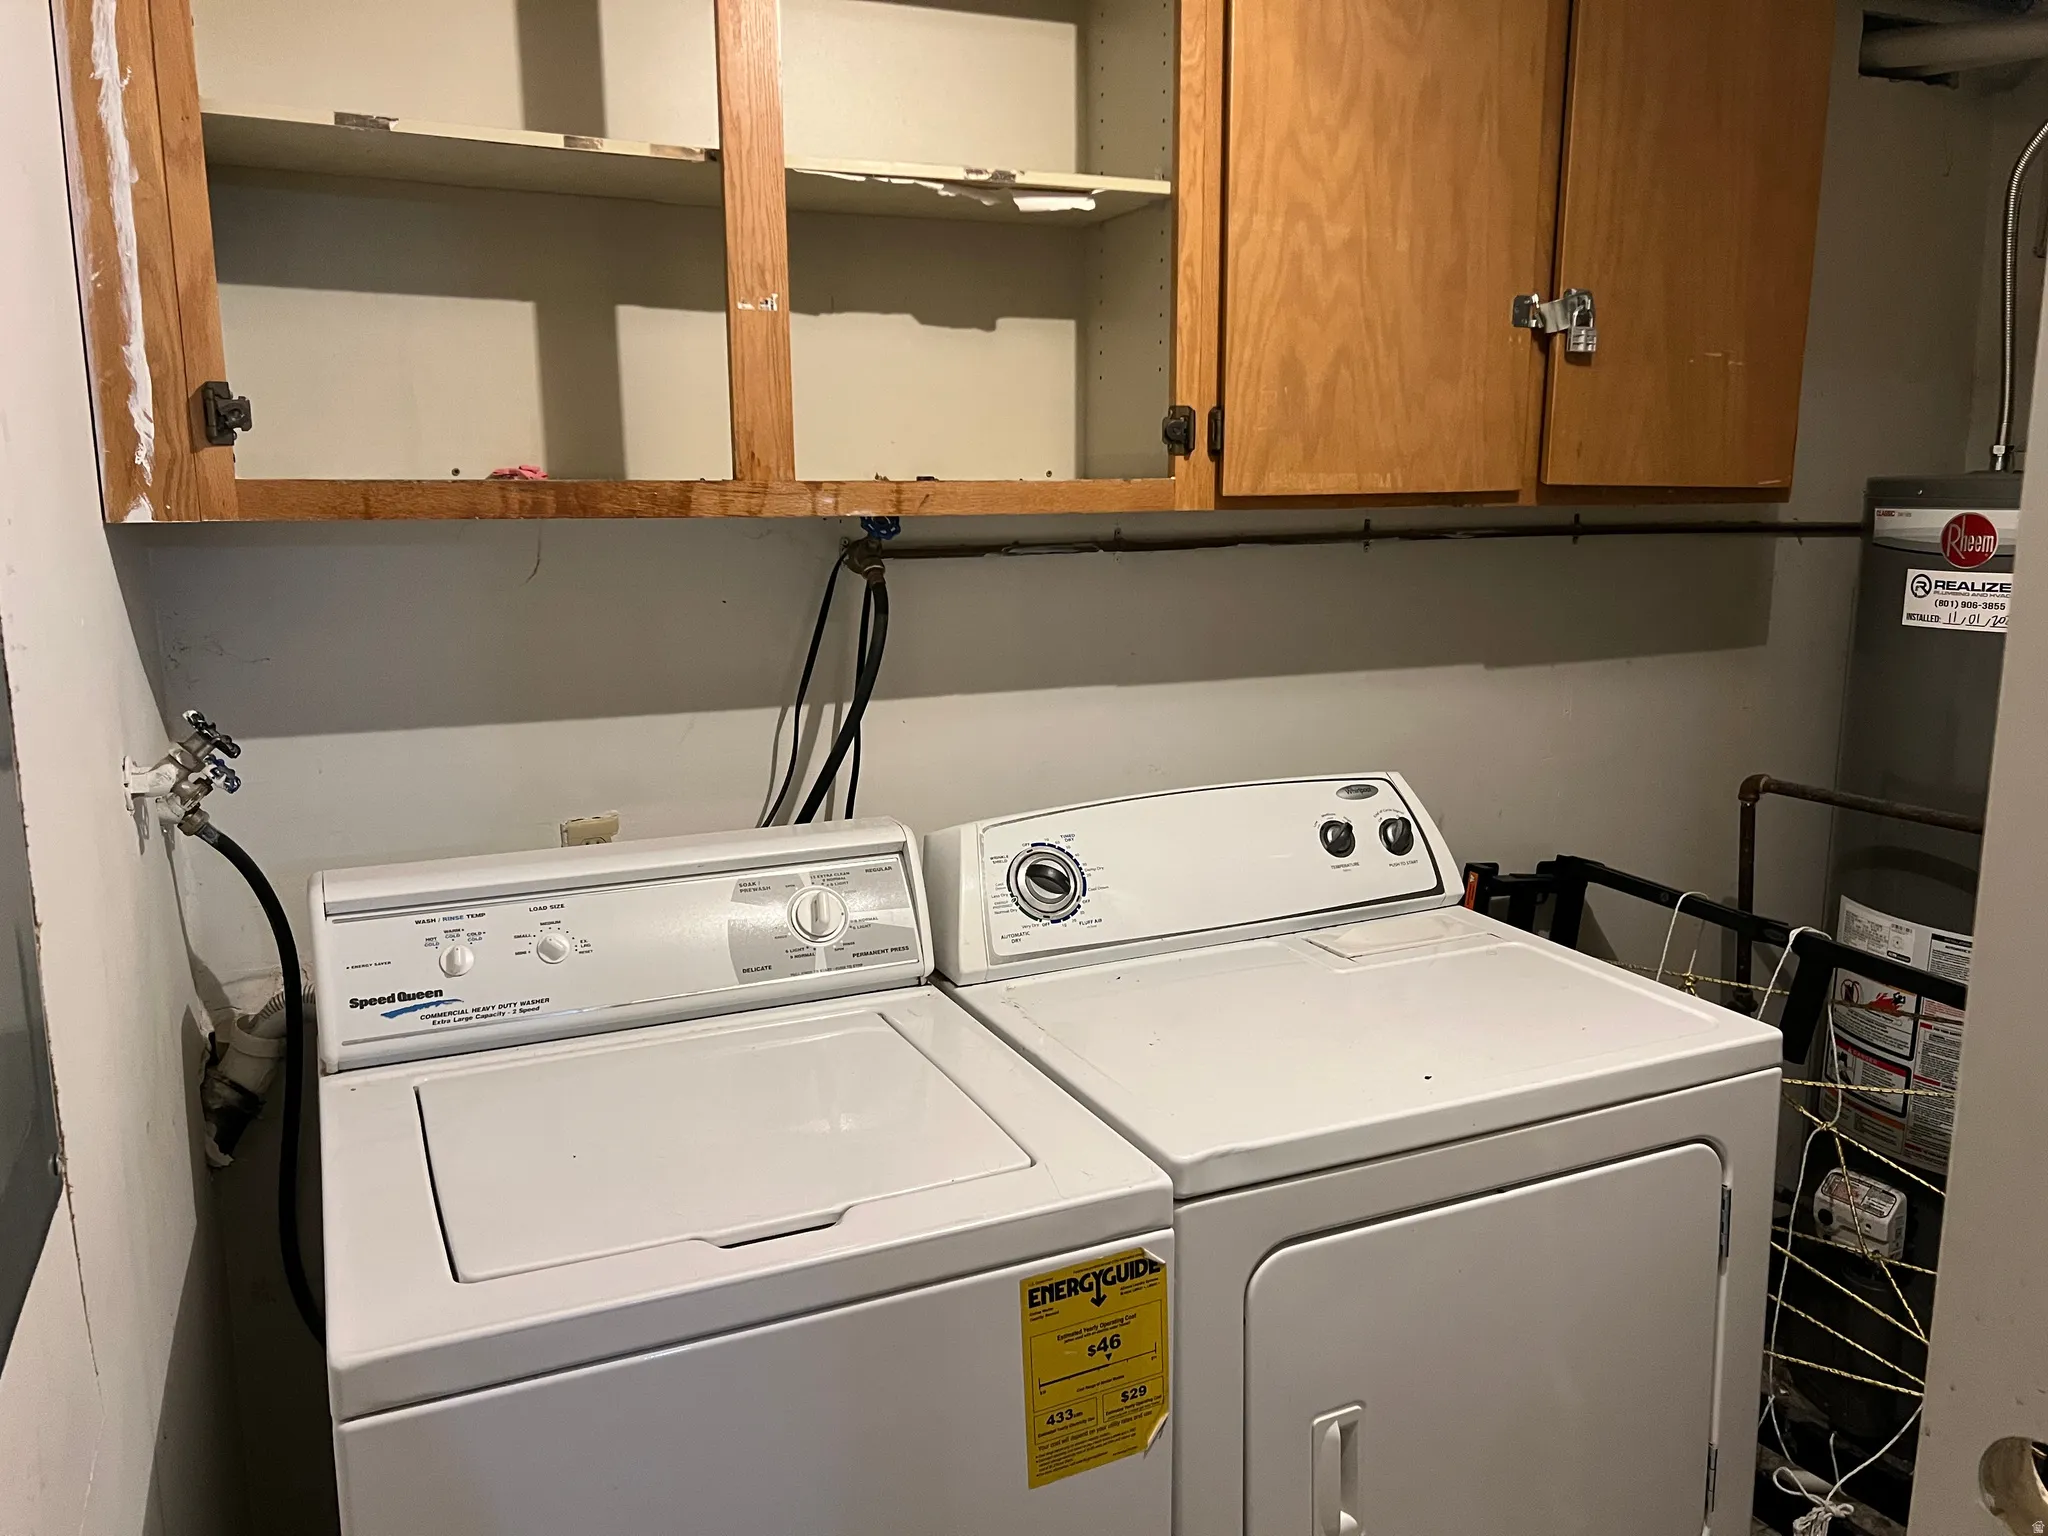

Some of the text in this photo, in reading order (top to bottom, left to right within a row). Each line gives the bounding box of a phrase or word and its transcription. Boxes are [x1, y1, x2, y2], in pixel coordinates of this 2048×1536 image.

[1946, 515, 1995, 560] Rheem
[1934, 580, 2012, 593] REALIZE
[1934, 599, 2006, 611] (801) 906-3855
[1905, 612, 1941, 623] INSTALLED:
[1344, 787, 1372, 795] Whirlpool
[739, 886, 771, 894] PREWASH
[1001, 931, 1031, 940] AUTOMATIC
[852, 945, 910, 958] PERMANENT PRESS
[742, 964, 773, 974] DELICATE
[349, 989, 444, 1010] Speed Queen
[419, 997, 550, 1021] COMMERCIAL HEAVY DUTY WASHER
[432, 1018, 451, 1026] Extra
[453, 1014, 473, 1024] Large
[475, 1010, 506, 1021] Capacity
[518, 1005, 540, 1015] Speed
[1028, 1258, 1162, 1309] ENERGYGUIDE
[1057, 1313, 1137, 1341] Estimated Yearly Operating Cost
[1087, 1333, 1122, 1358] $46
[1121, 1385, 1147, 1404] $29
[1046, 1408, 1074, 1426] 433
